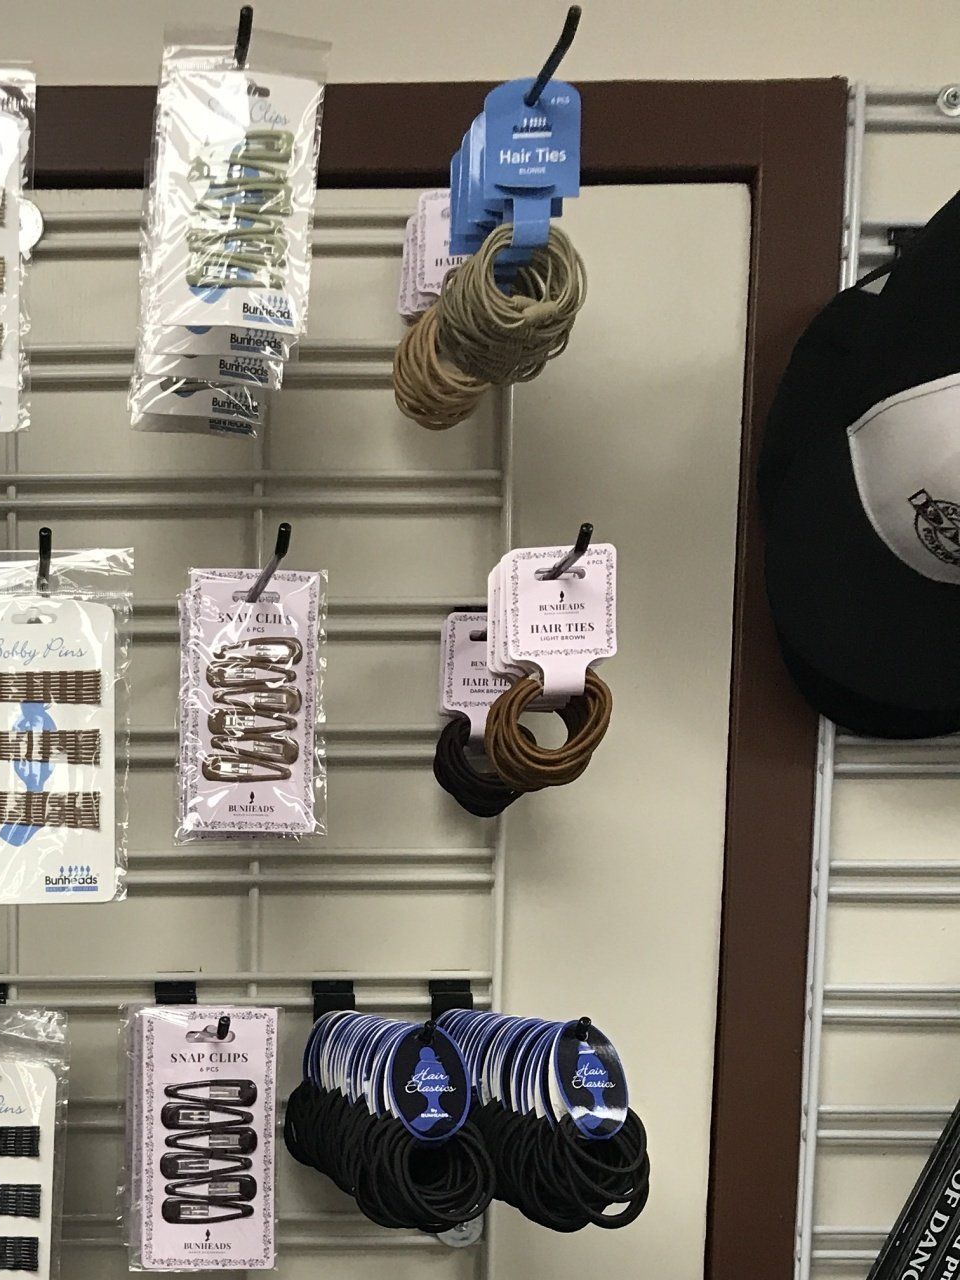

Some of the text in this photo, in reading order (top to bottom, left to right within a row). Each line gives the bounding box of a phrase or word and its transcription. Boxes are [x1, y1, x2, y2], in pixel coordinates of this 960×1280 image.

[251, 102, 290, 128] Clips
[499, 148, 566, 164] Hair Ties
[435, 257, 463, 267] HAIR
[230, 333, 282, 349] Bunheads
[219, 360, 269, 376] Bunheads
[539, 603, 585, 612] BUNHEADS
[530, 623, 595, 634] HAIR TIES
[43, 637, 87, 658] Pins
[462, 678, 489, 686] HAIR
[228, 804, 275, 813] BUNHEADS
[45, 875, 98, 885] Bunheads
[170, 1053, 249, 1063] SNAP CLIPS
[412, 1067, 447, 1081] Hair
[577, 1063, 606, 1076] Hair
[405, 1080, 456, 1094] Elastics
[572, 1075, 616, 1089] Elastics
[183, 1242, 231, 1250] BUNHEADS
